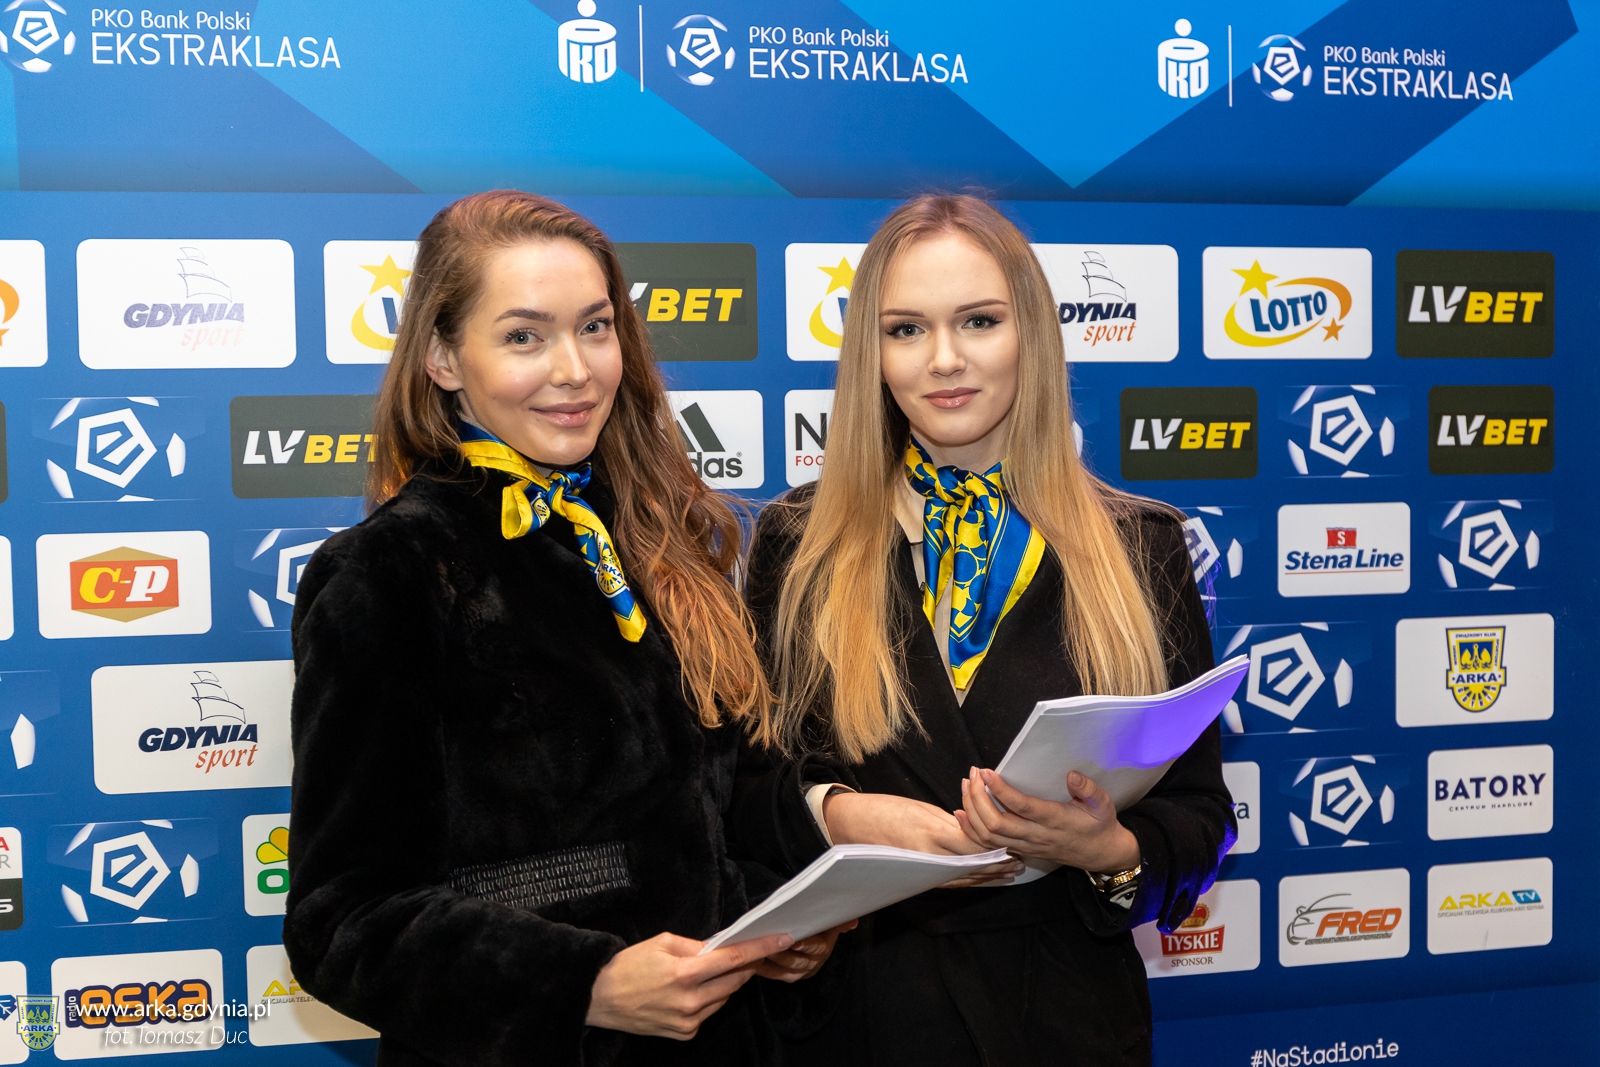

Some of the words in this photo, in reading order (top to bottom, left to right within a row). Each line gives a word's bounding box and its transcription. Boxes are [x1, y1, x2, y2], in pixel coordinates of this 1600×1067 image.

[91, 9, 134, 28] PKO
[141, 10, 189, 29] Bank
[196, 11, 251, 31] Polski
[91, 32, 342, 68] EKSTRAKLASA
[749, 26, 786, 45] PKO
[792, 27, 835, 46] Bank
[841, 29, 890, 48] Polski
[749, 48, 969, 84] EKSTRAKLASA
[1323, 45, 1357, 64] PKO
[1361, 47, 1399, 65] Bank
[1404, 48, 1446, 67] Polski
[1323, 66, 1514, 101] EKSTRAKLASA
[123, 302, 245, 329] GDYNIA
[628, 282, 743, 322] BET
[1057, 302, 1137, 324] DYNIA
[1250, 291, 1328, 332] LOTTO
[180, 324, 245, 351] sport
[1084, 321, 1136, 347] sport
[689, 452, 743, 478] das
[1285, 550, 1353, 570] Stena
[1355, 548, 1404, 568] Line
[1455, 673, 1498, 684] ARKA
[138, 723, 258, 753] GDYNIA
[195, 744, 258, 774] sport
[1435, 773, 1546, 801] BATORY
[1439, 891, 1513, 911] ARKA
[1516, 891, 1536, 902] TV
[1316, 907, 1402, 937] FRED
[1165, 930, 1220, 952] TYSKIE
[1171, 956, 1214, 968] SPONSOR
[1251, 1038, 1399, 1067] #NaStadionie
